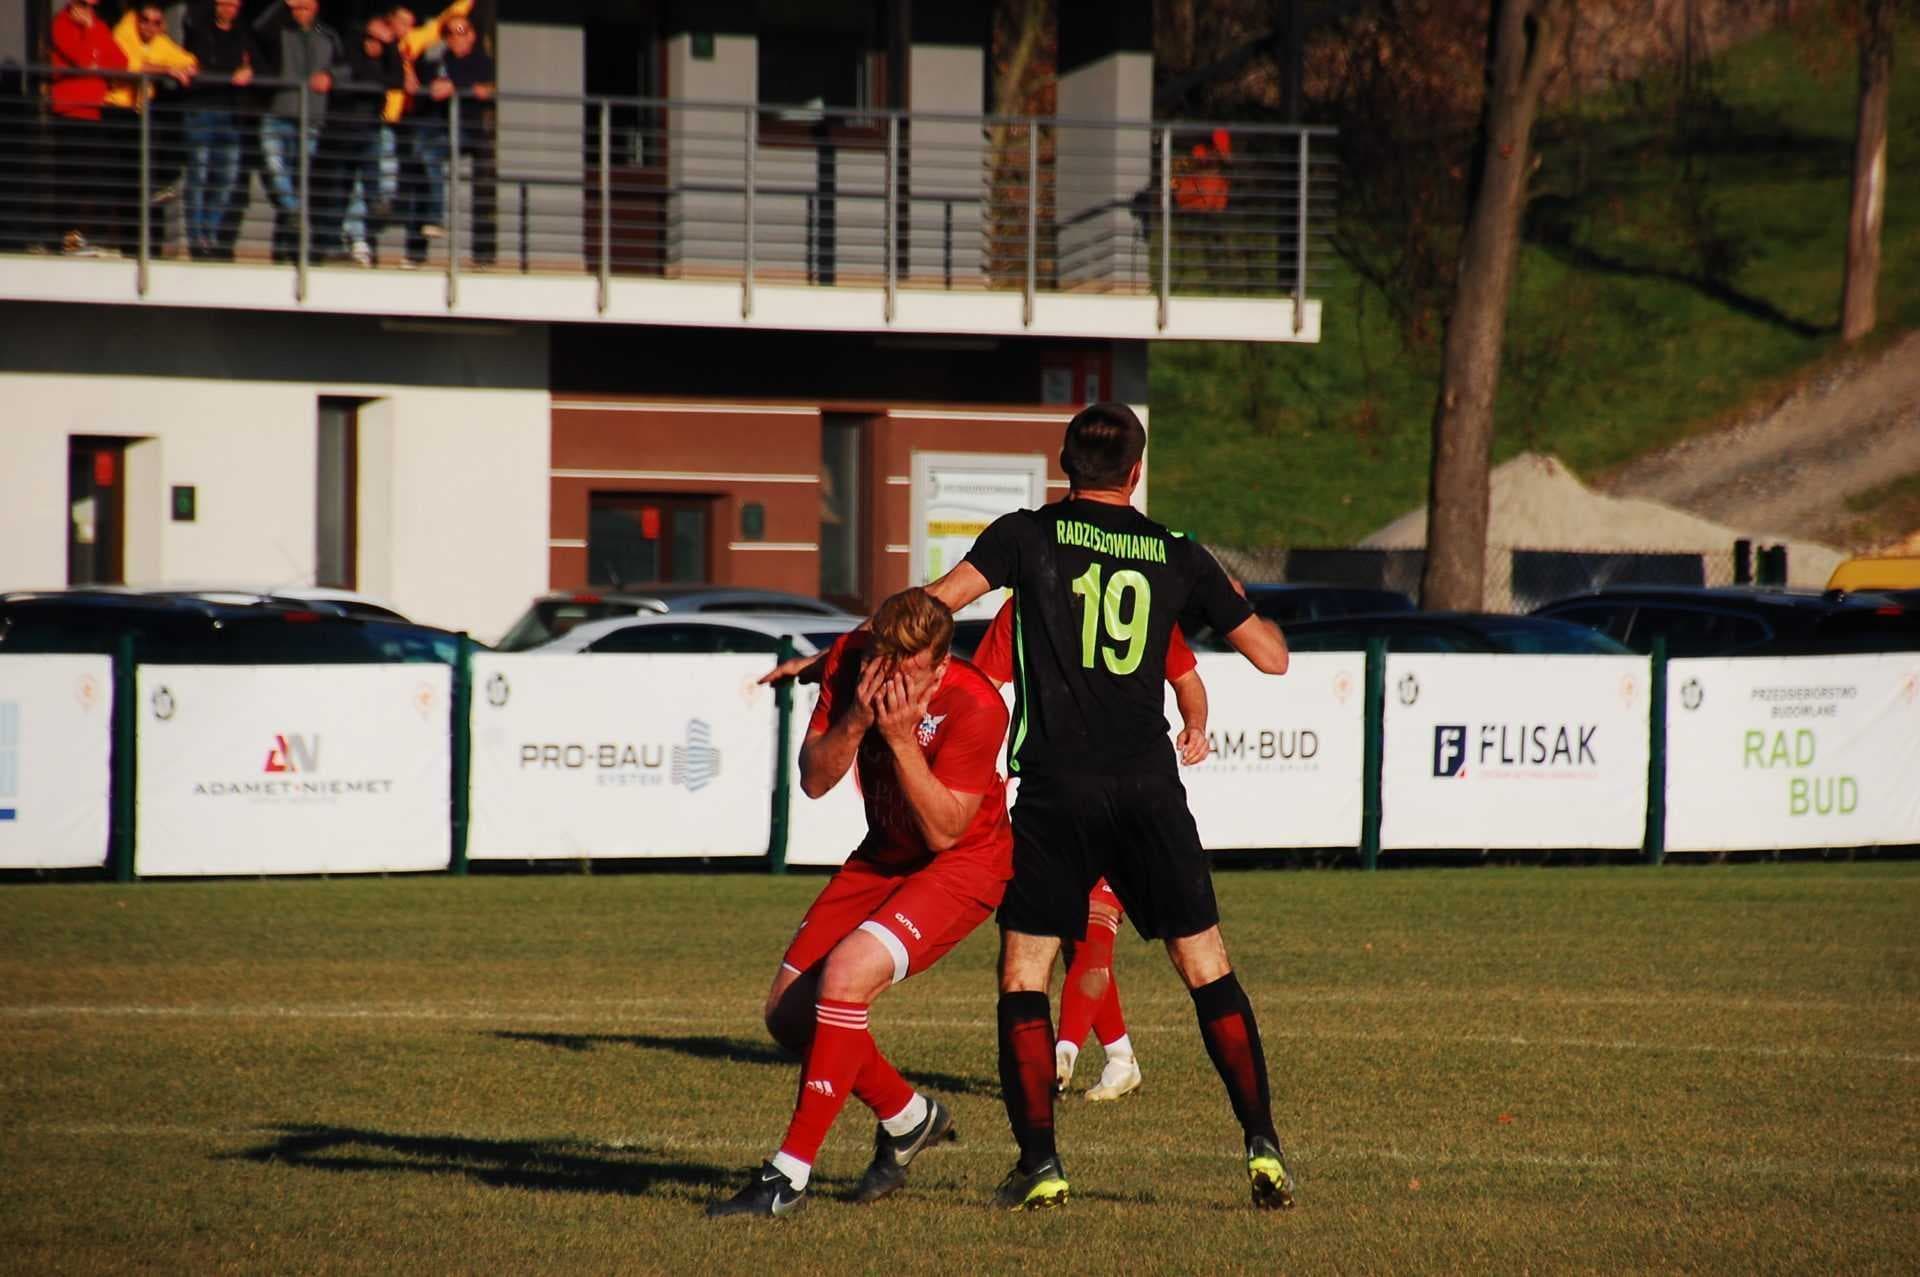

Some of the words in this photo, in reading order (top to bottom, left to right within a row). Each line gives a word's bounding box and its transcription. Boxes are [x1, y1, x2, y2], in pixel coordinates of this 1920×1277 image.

[1056, 520, 1166, 564] RADZISZOWIANKA
[1072, 562, 1151, 675] 19
[520, 744, 663, 768] PRO-BAU
[1182, 731, 1319, 760] AM-BUD
[1481, 725, 1597, 764] FLISAK
[1744, 729, 1816, 768] RAD
[1789, 776, 1859, 816] BUD
